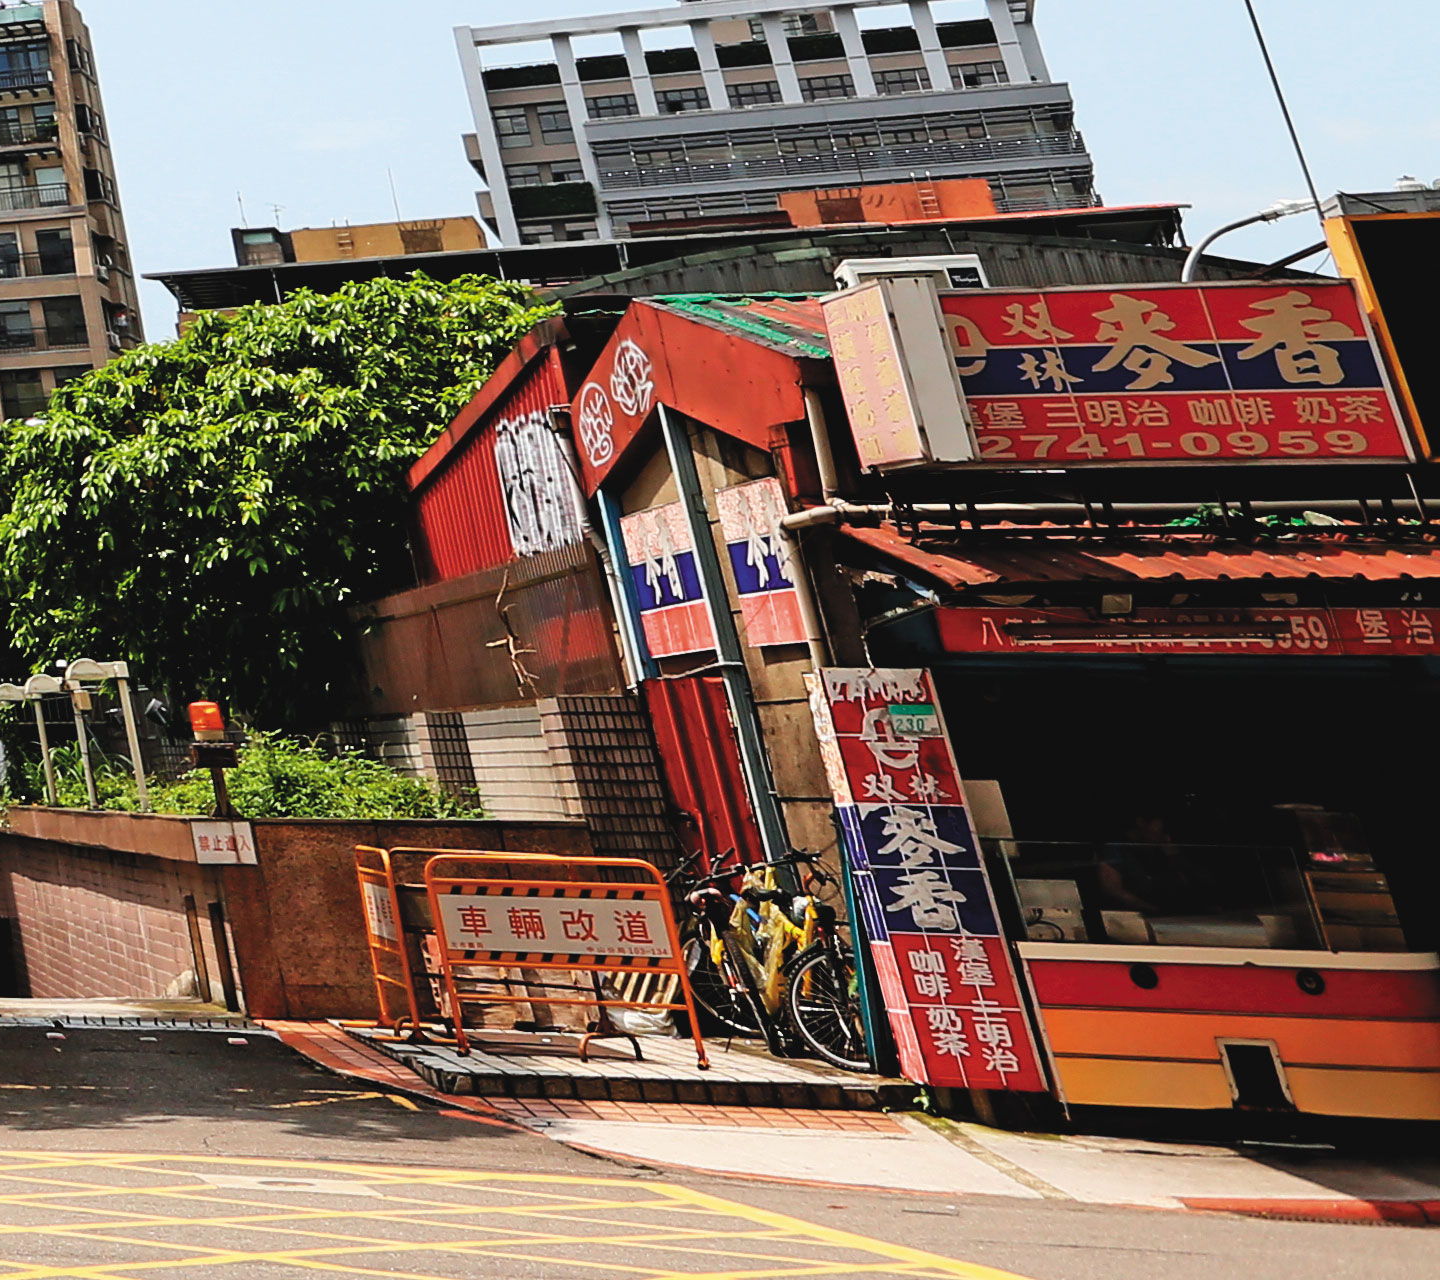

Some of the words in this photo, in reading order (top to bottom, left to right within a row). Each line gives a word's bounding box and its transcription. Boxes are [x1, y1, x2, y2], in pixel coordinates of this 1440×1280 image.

[1042, 399, 1171, 428] 三明治
[1187, 397, 1276, 426] 咖啡
[1293, 395, 1385, 424] 奶茶
[978, 429, 1369, 458] 2741-0959
[896, 718, 925, 733] 230
[457, 905, 654, 945] 車輛改道
[908, 948, 952, 999] 咖啡
[950, 937, 996, 987] 漢堡
[927, 1006, 972, 1057] 奶茶
[971, 1000, 1020, 1073] 三明治
